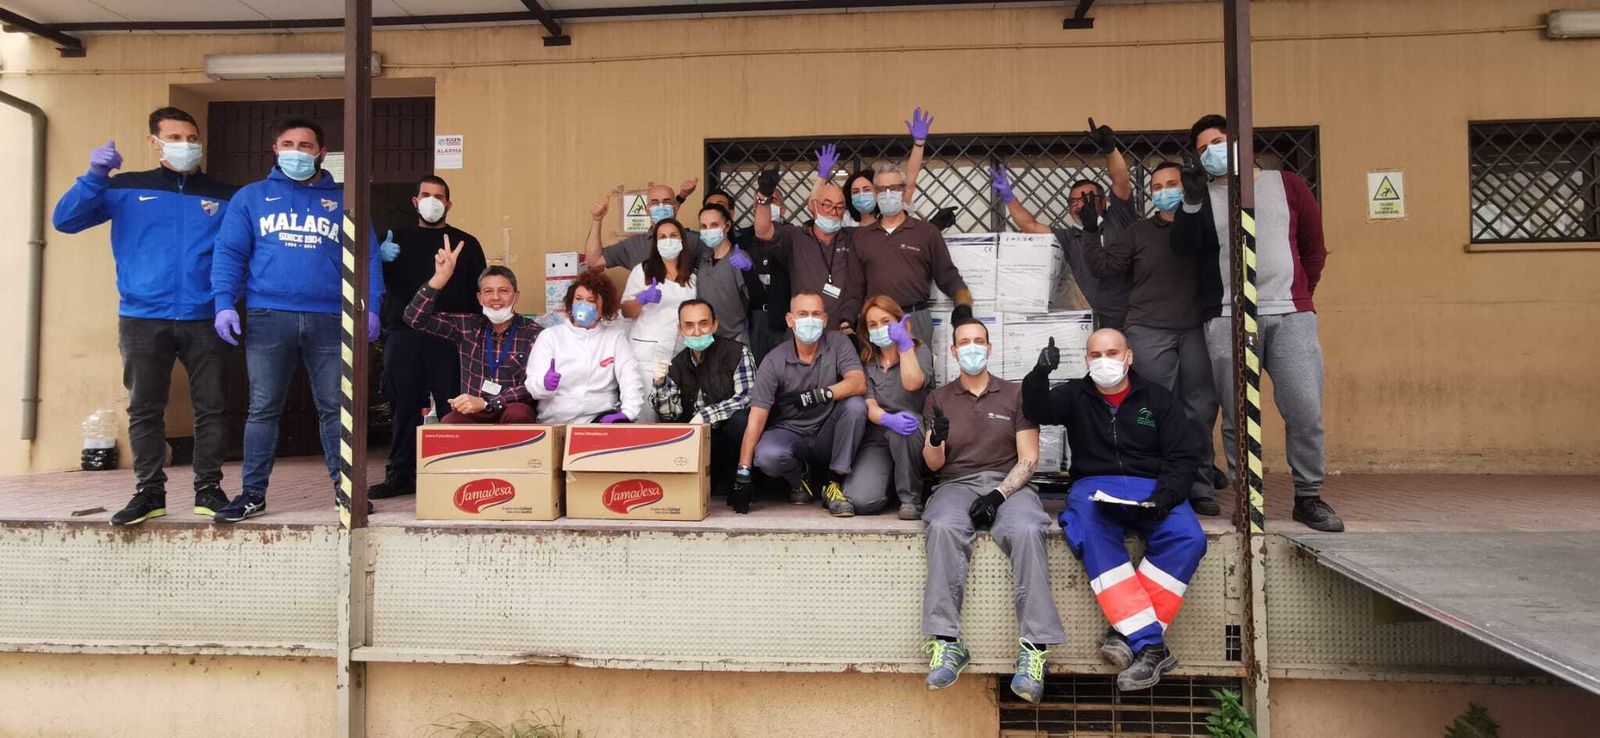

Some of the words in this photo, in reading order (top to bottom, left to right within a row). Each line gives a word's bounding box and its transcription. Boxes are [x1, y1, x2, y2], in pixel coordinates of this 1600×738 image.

[259, 212, 340, 243] MALAGA
[279, 232, 303, 242] SINCE
[304, 234, 322, 244] 1904
[459, 481, 513, 506] famadesa
[608, 481, 661, 506] famadesa
